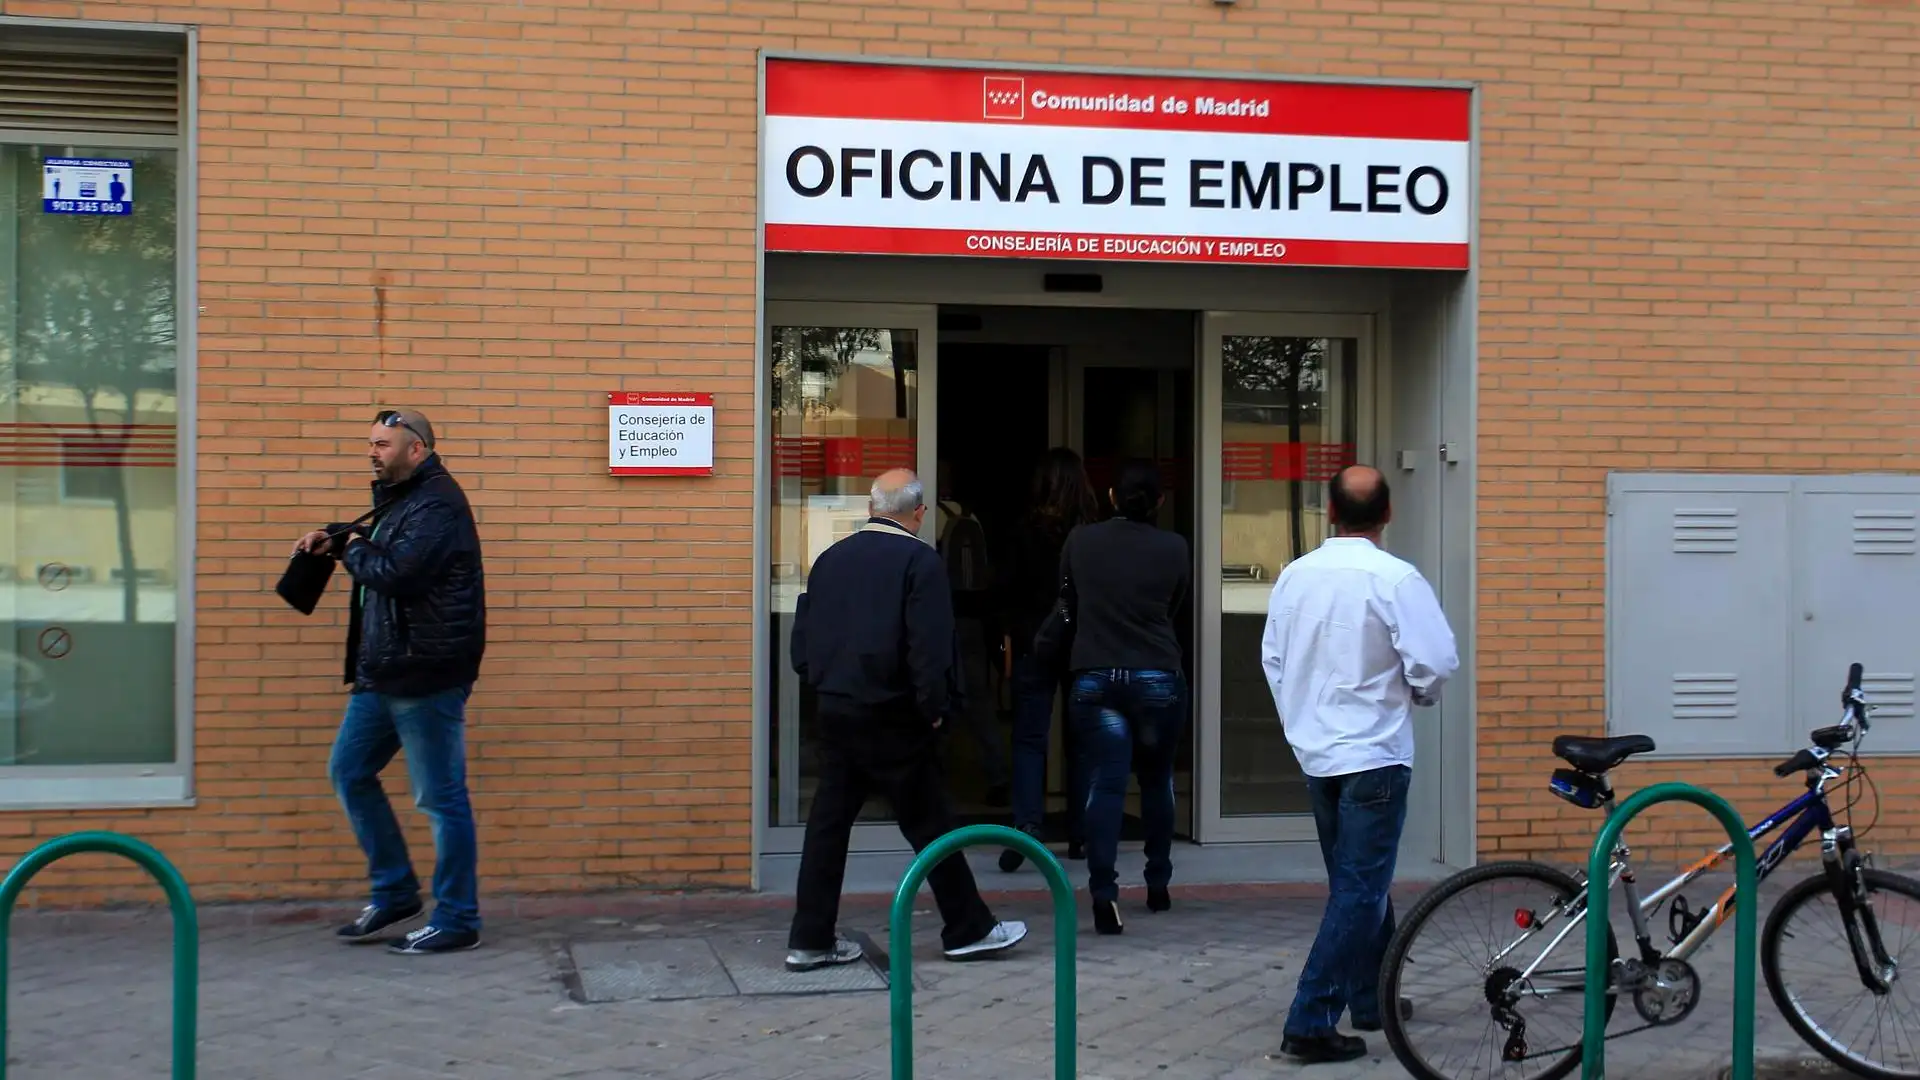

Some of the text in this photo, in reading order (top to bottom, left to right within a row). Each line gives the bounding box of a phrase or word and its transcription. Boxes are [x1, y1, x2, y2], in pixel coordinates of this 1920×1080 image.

[1031, 90, 1270, 117] Comunidad de Madrid
[786, 145, 1449, 215] OFICINA DE EMPLEO
[51, 201, 124, 213] 902 365 060
[966, 234, 1286, 257] CONSEJERÍA DE EDUCACIÓN Y EMPLEO
[618, 413, 705, 427] Consejería de
[619, 429, 684, 441] Educación
[619, 446, 678, 459] y Empleo
